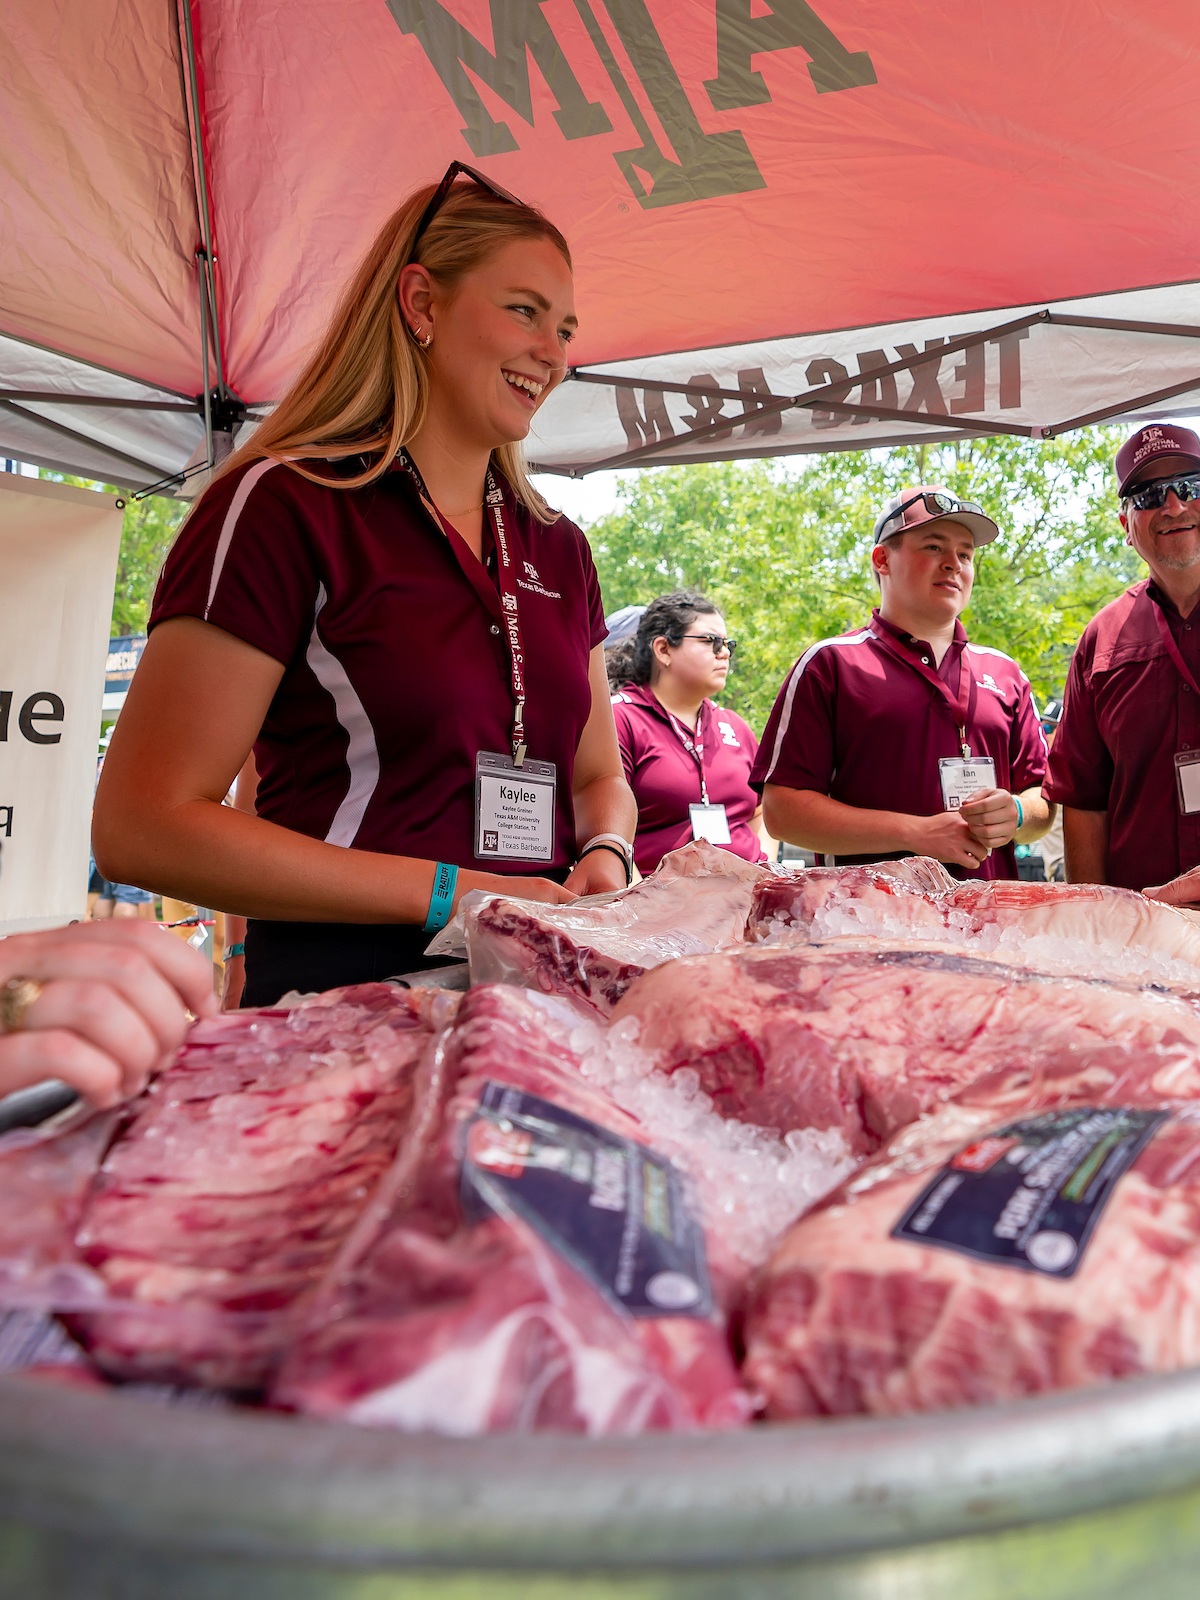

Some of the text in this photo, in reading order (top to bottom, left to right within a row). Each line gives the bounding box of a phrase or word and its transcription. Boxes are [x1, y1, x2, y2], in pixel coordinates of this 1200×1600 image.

[507, 618, 522, 651] Meat
[500, 786, 536, 803] Kaylee
[502, 805, 516, 813] Kaylee
[494, 812, 507, 820] Texas
[520, 815, 540, 824] University
[497, 821, 513, 830] College
[502, 841, 520, 850] Texas
[521, 843, 548, 853] Barbecue
